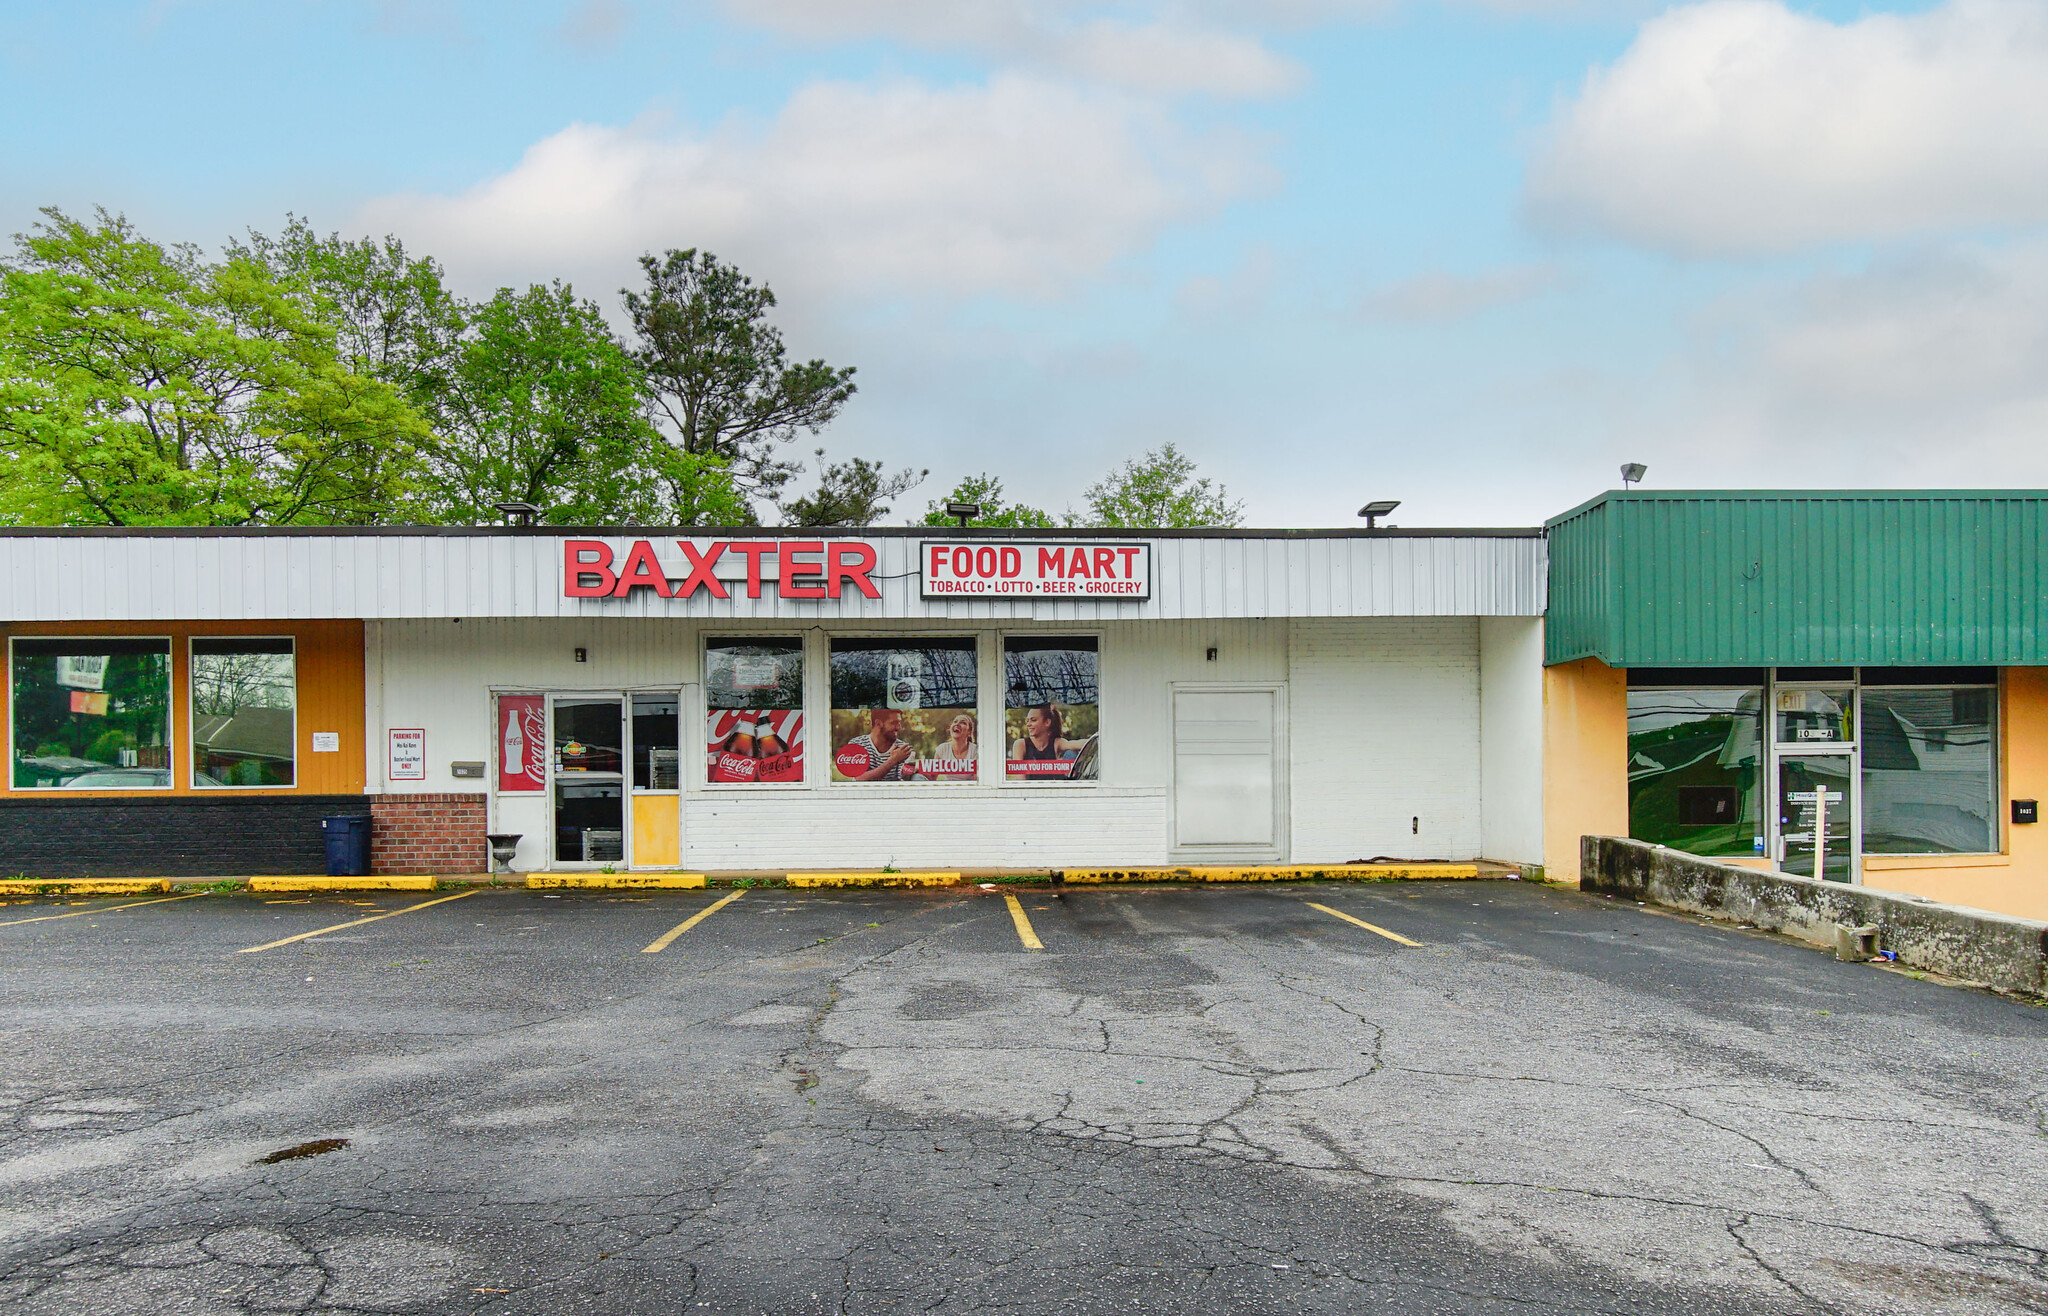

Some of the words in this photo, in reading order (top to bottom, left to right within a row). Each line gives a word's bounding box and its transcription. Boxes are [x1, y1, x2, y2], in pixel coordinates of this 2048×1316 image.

[564, 540, 882, 598] BAXTER
[930, 546, 1021, 579] FOOD
[1038, 546, 1140, 579] MART
[929, 580, 985, 593] TOBACCO
[994, 580, 1034, 593] LOTTO
[1043, 580, 1076, 593] BEER
[1085, 580, 1142, 593] GROCERY
[1782, 695, 1801, 710] EXIT
[719, 753, 757, 775] Coca-Cola
[759, 755, 792, 776] Coca-Cola
[836, 753, 869, 765] Coca-Cola
[922, 759, 974, 773] WELCOME
[1008, 763, 1028, 771] THANK
[1029, 763, 1040, 771] YOU
[1041, 763, 1053, 771] FOR
